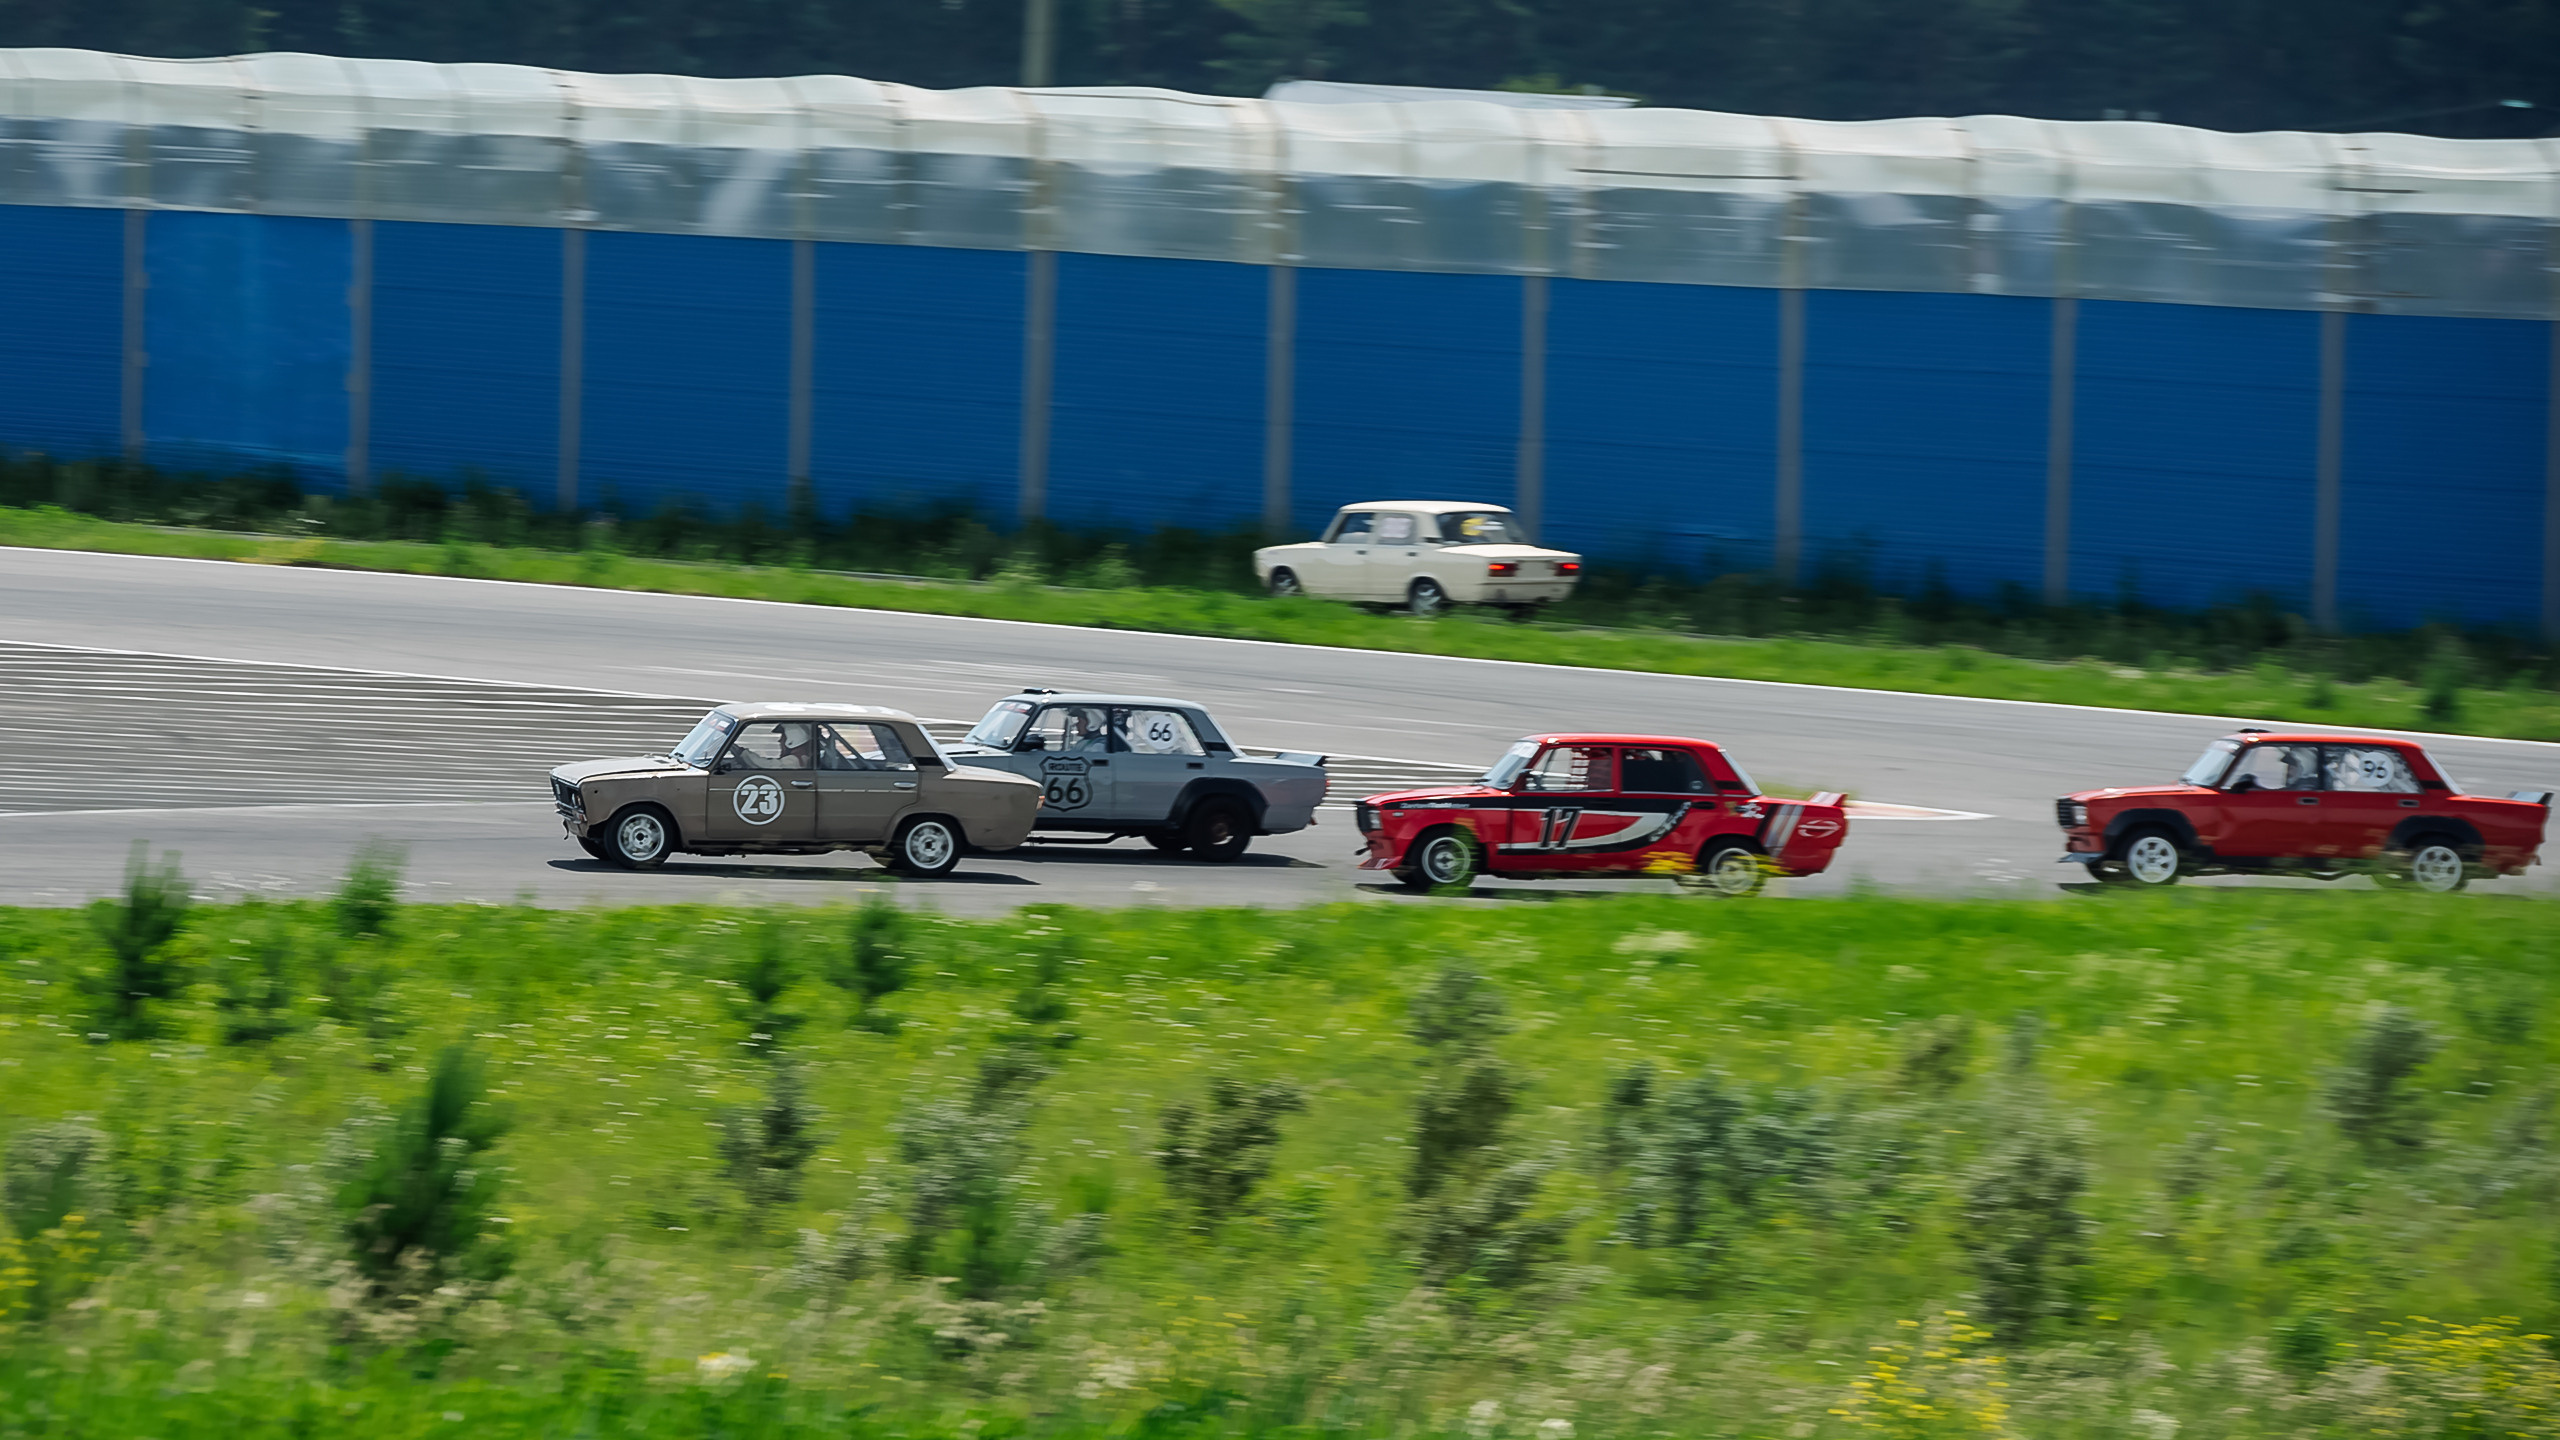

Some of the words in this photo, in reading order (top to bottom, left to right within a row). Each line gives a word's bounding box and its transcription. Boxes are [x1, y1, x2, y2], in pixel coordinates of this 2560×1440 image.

[1148, 721, 1174, 742] 66
[2363, 760, 2389, 778] 96
[740, 783, 778, 815] 23
[1046, 777, 1084, 804] 66
[1539, 806, 1583, 850] 17
